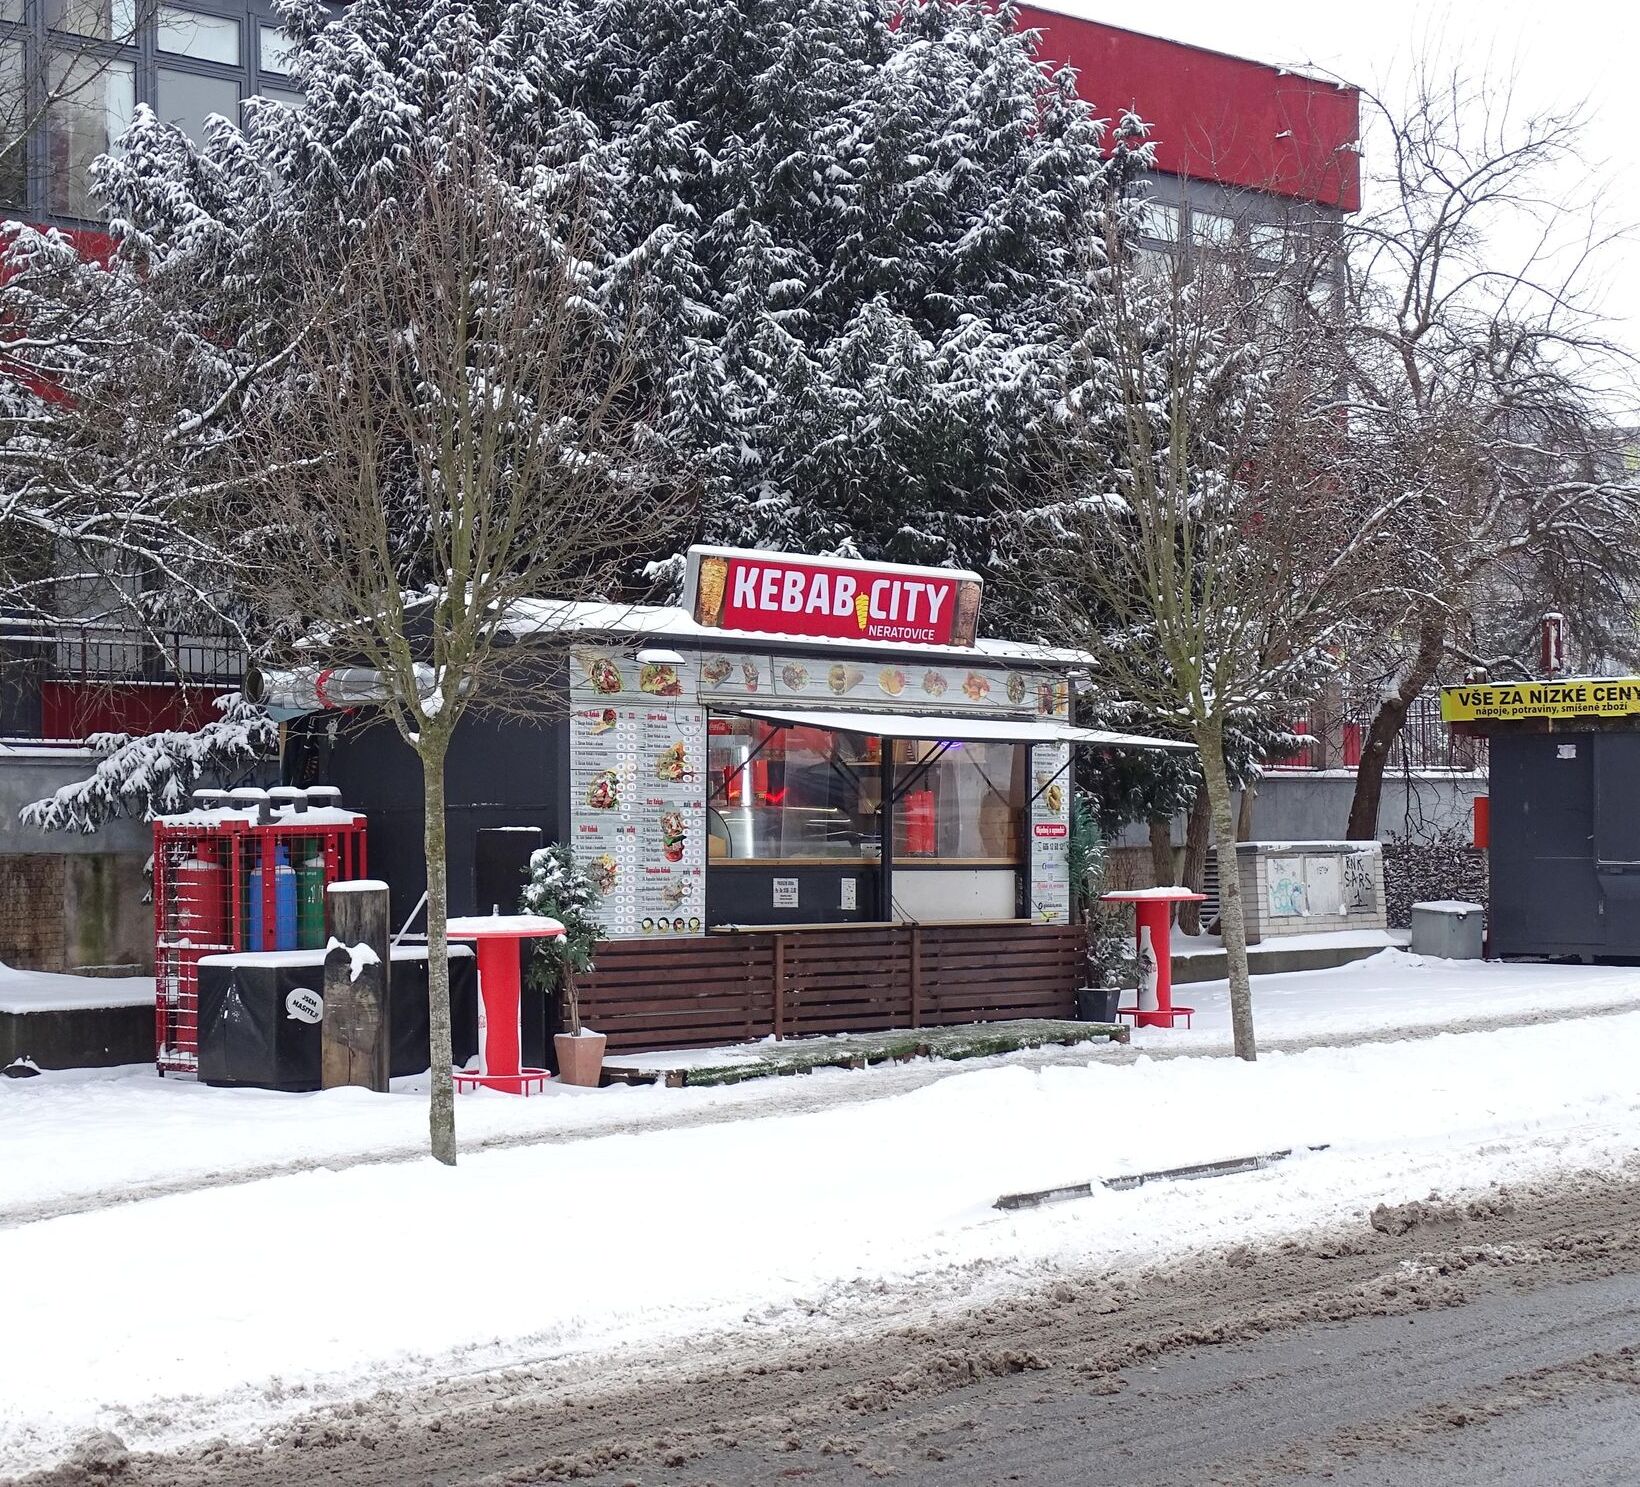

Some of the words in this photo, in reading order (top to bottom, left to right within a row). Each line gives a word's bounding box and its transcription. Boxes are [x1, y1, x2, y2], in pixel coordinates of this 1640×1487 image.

[733, 566, 857, 617] KEBAB
[869, 579, 949, 624] CITY
[868, 625, 935, 641] NERATOVICE
[1458, 689, 1493, 706] VŠE
[1500, 690, 1523, 705] ZA
[1530, 685, 1586, 704] NÍZKÉ
[1512, 704, 1559, 716] potraviny,
[302, 995, 317, 1007] JSEM
